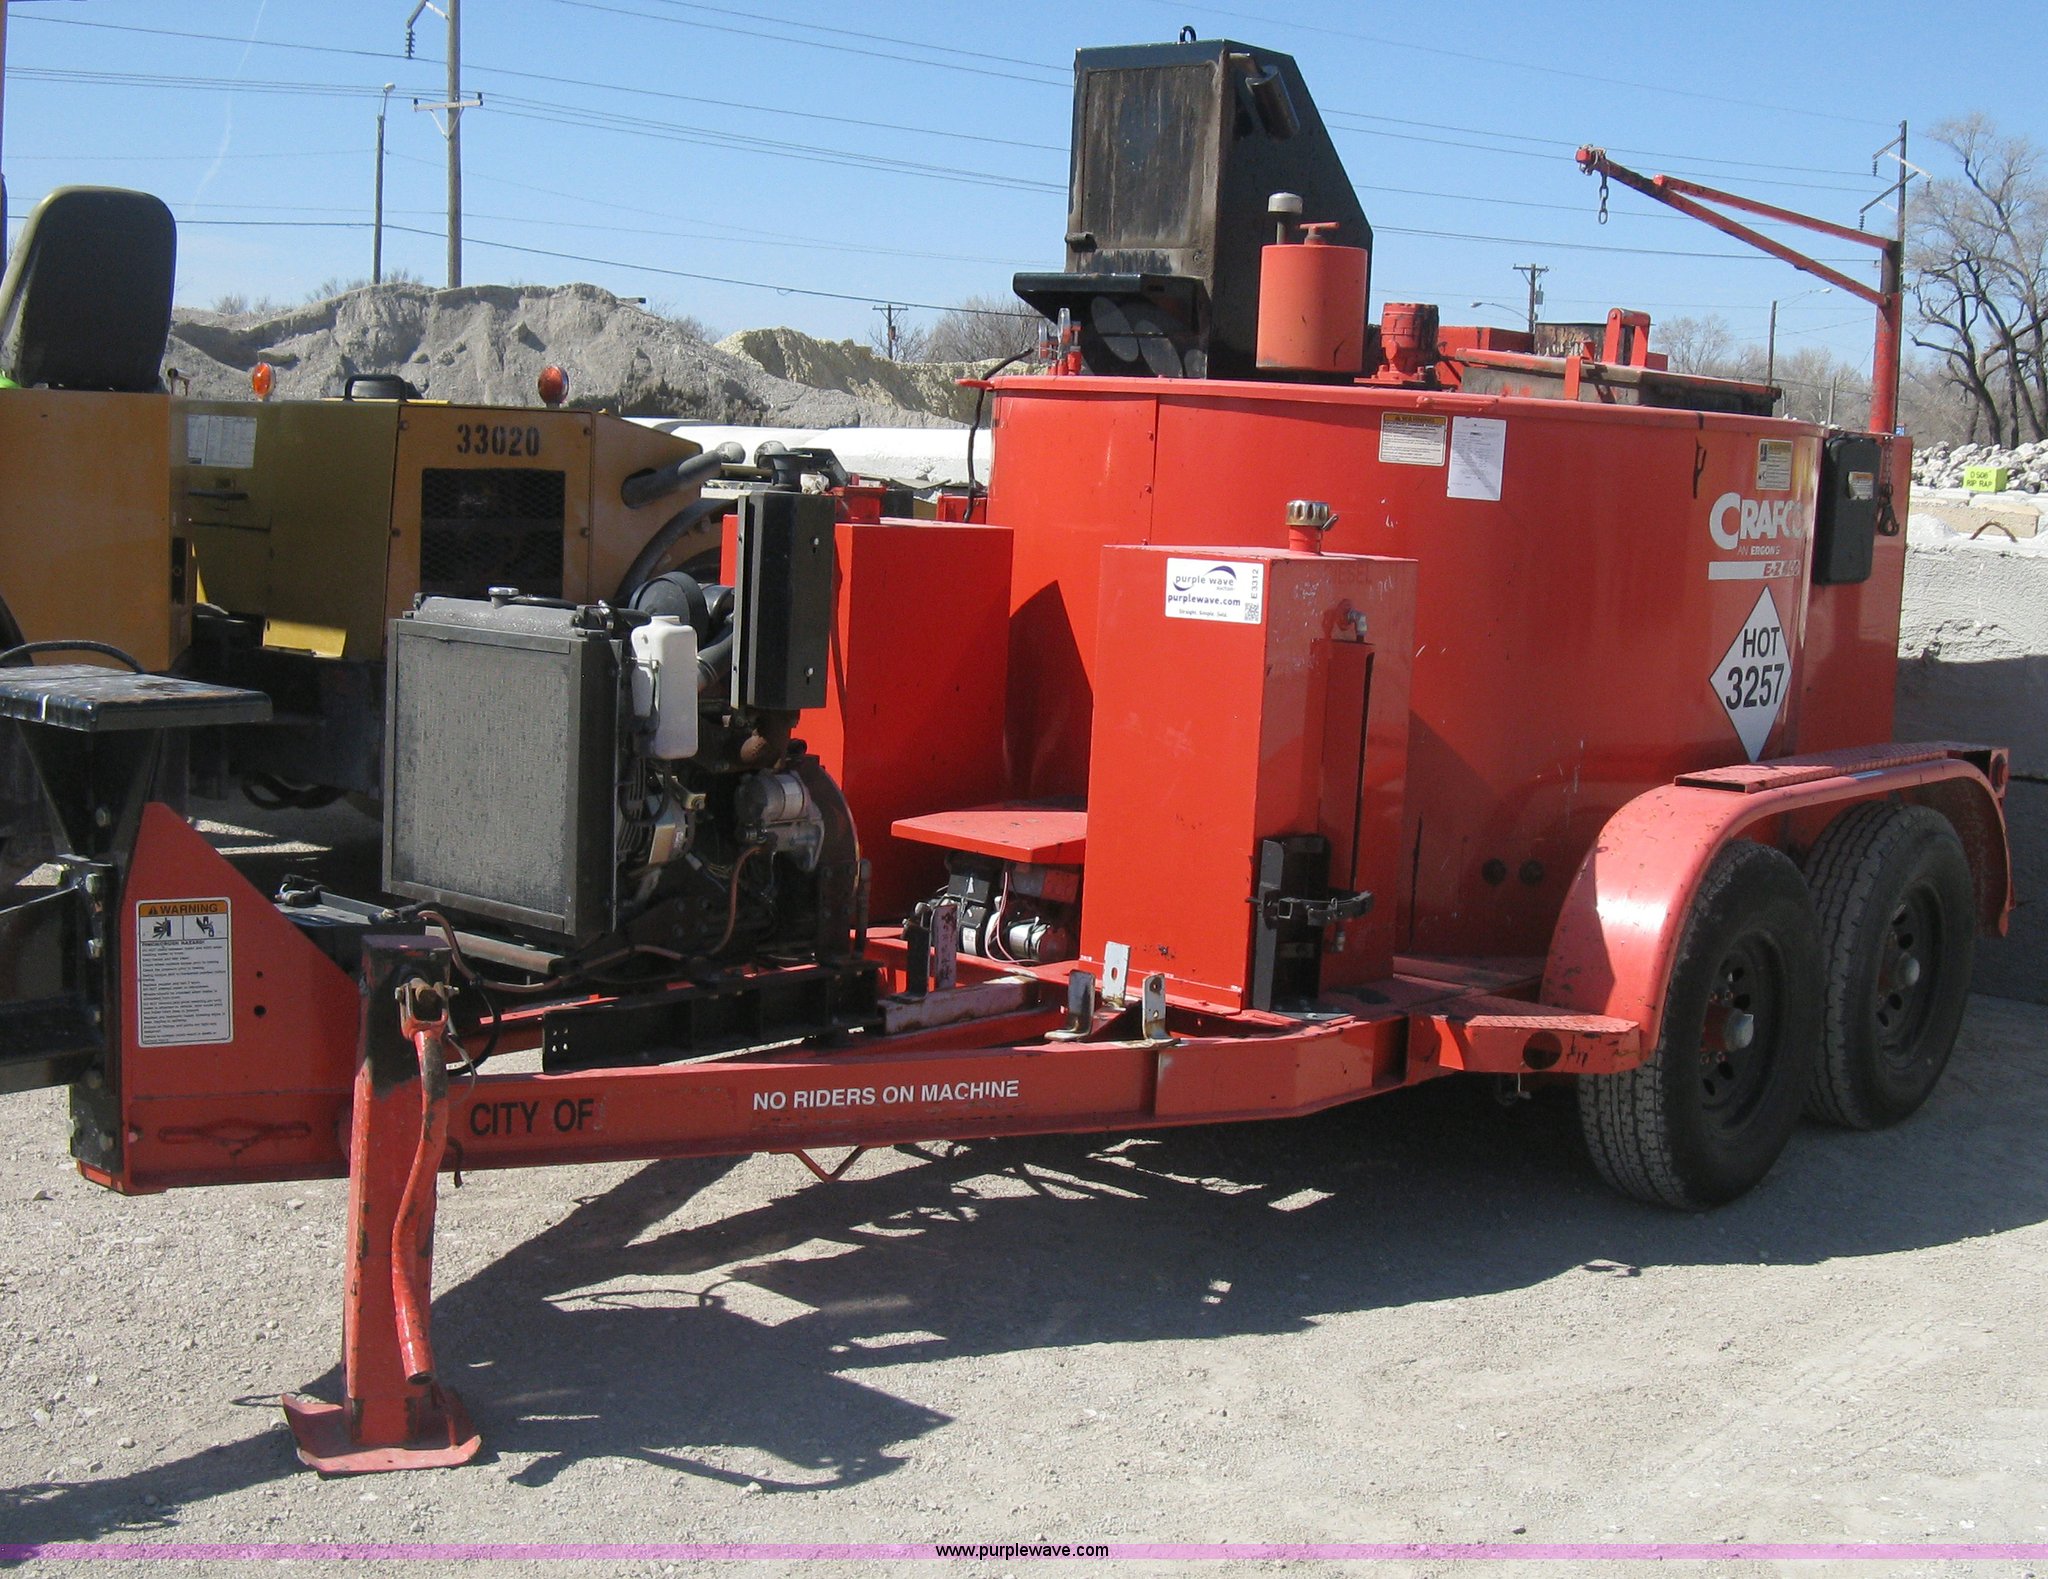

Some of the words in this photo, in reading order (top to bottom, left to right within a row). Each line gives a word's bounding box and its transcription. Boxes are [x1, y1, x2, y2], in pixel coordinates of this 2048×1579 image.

[457, 424, 540, 457] 33020
[1175, 574, 1206, 584] purple
[1209, 577, 1234, 586] wave
[1251, 568, 1259, 599] E3312
[1168, 594, 1241, 606] purplewave.com
[1742, 626, 1780, 659] HOT
[1725, 663, 1785, 710] 3257
[160, 903, 218, 915] WARNING
[753, 1091, 786, 1111] NO
[793, 1087, 876, 1109] RIDERS
[882, 1085, 915, 1105] ON
[921, 1080, 1019, 1103] MACHINE
[470, 1101, 540, 1137] CITY
[553, 1098, 595, 1133] OF
